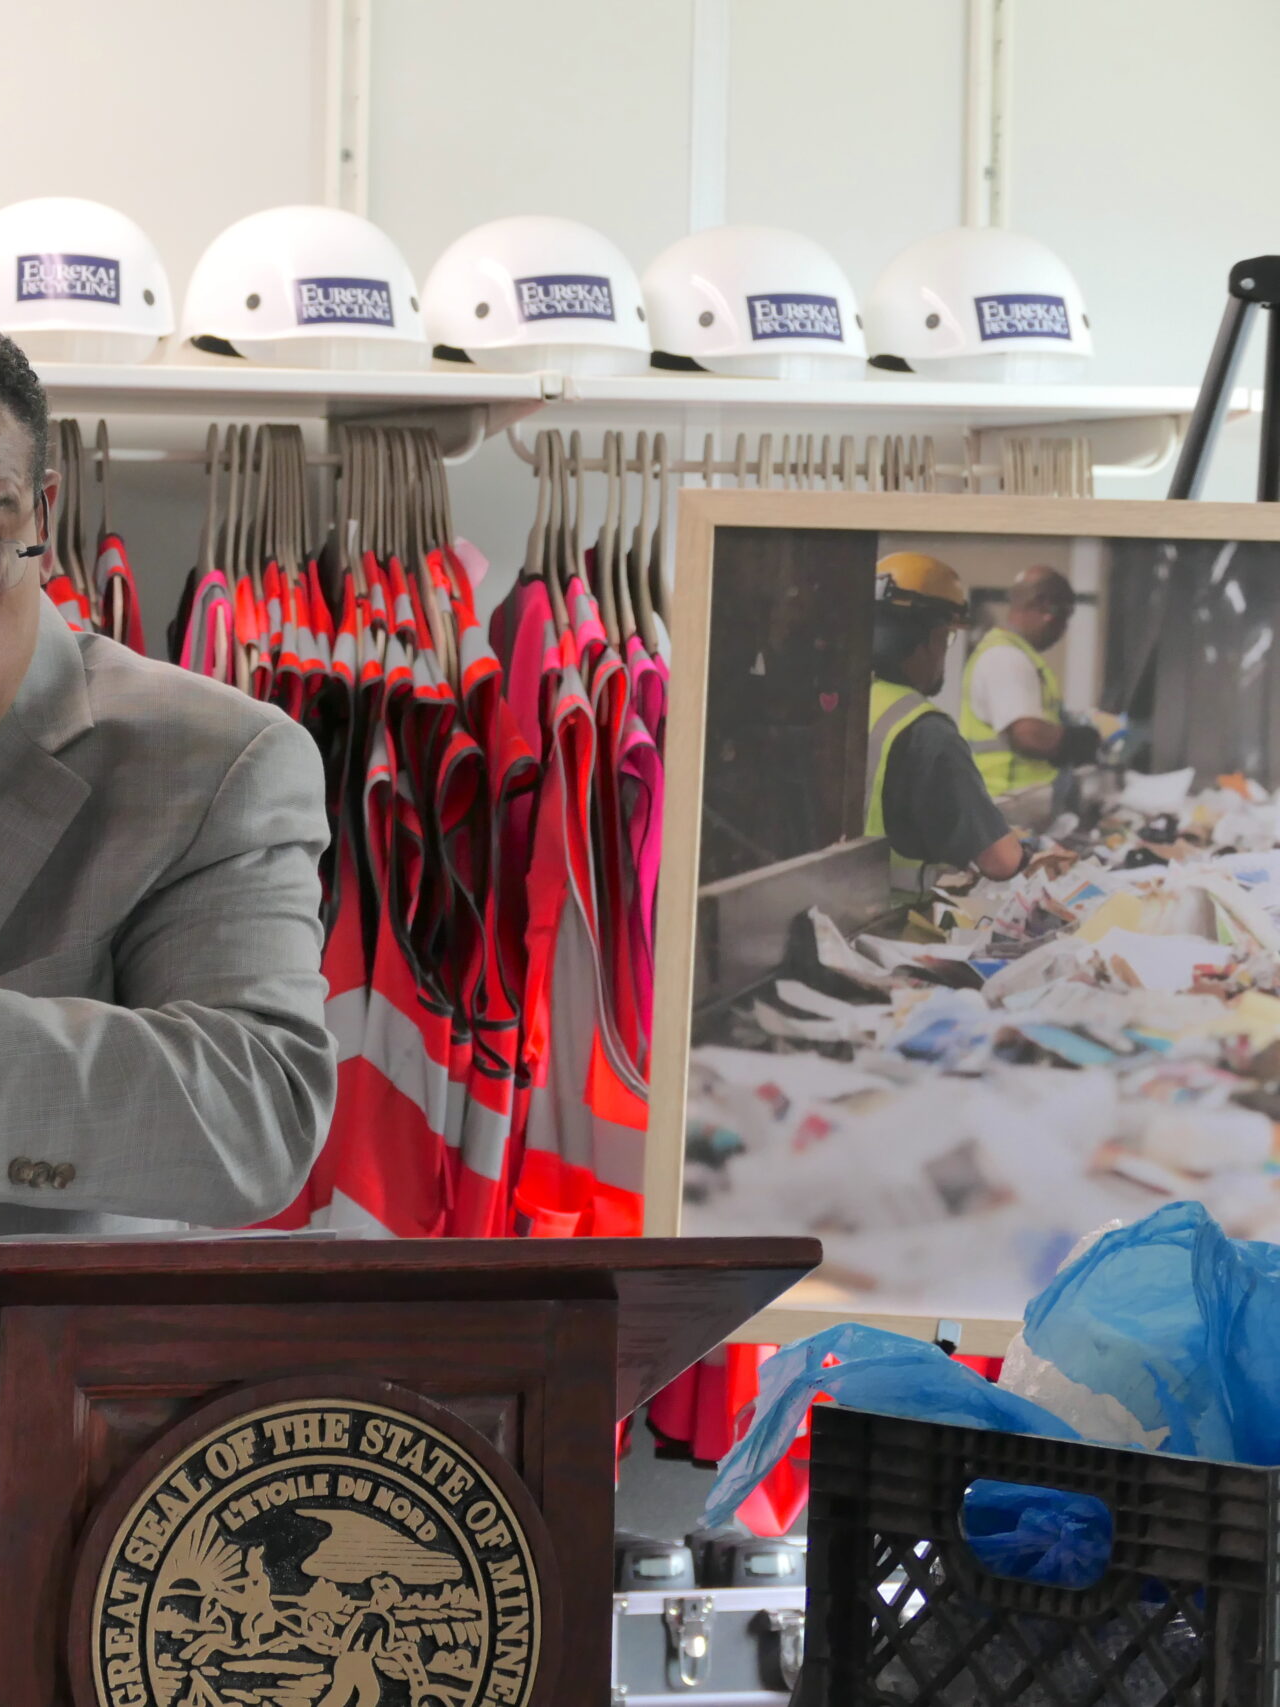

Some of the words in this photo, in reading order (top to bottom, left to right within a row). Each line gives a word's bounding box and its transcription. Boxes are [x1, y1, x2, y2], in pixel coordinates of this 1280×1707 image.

[206, 1426, 259, 1478] OF
[266, 1413, 350, 1455] THE
[360, 1418, 475, 1504] STATE
[124, 1465, 211, 1570] SEAL
[337, 1474, 373, 1502] DU
[372, 1486, 438, 1542] NORD
[465, 1500, 513, 1554] OF
[104, 1570, 148, 1707] GREAT
